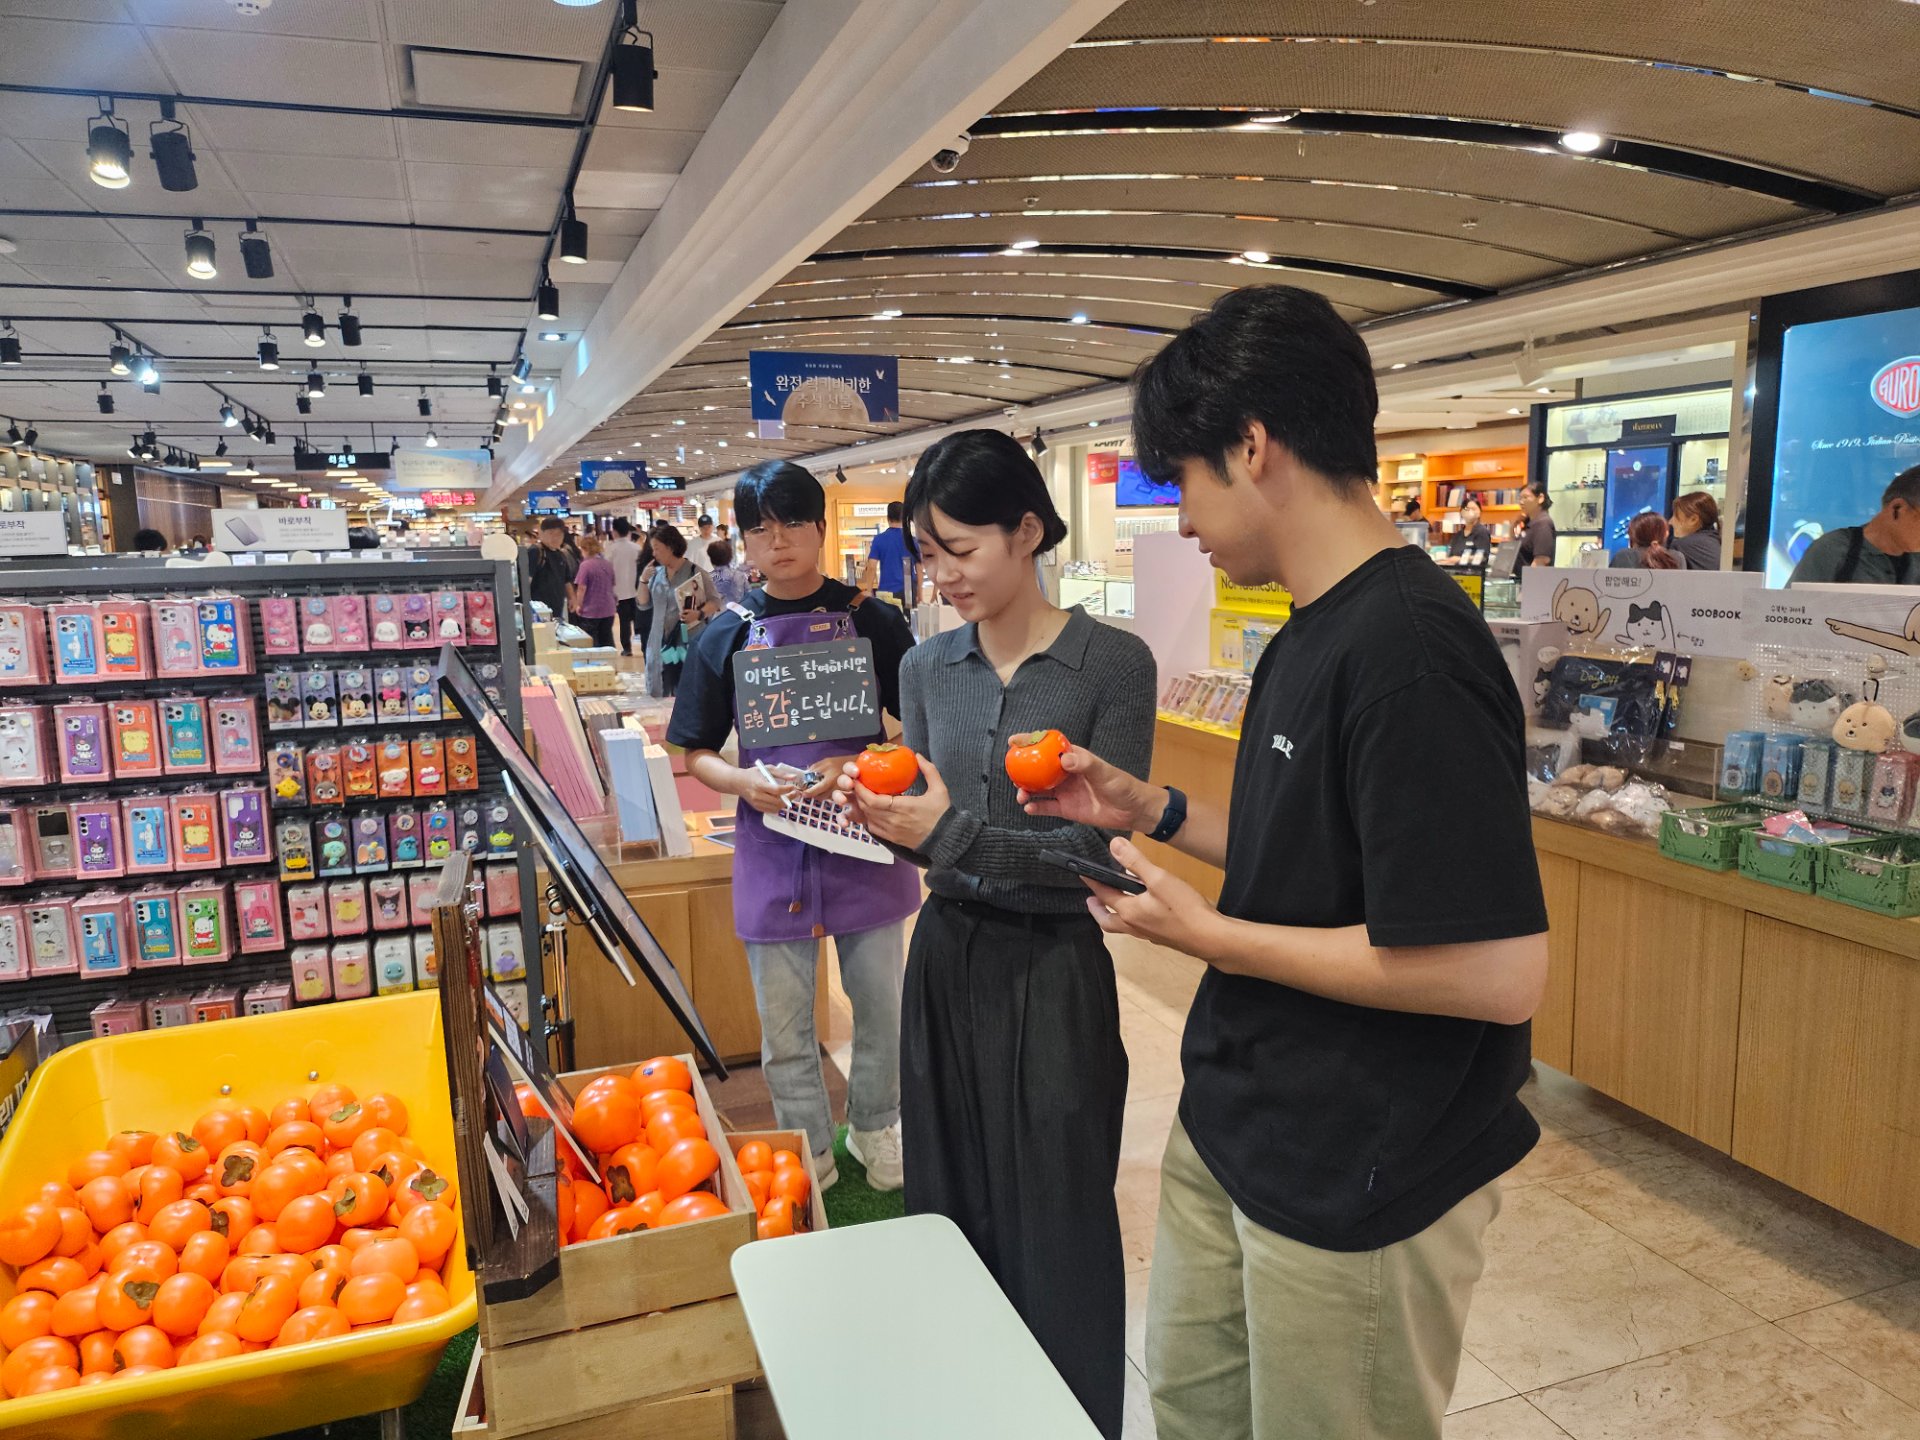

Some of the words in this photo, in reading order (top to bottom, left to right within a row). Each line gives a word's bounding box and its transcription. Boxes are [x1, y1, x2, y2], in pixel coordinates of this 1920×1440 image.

[775, 375, 802, 392] 완전
[1605, 576, 1642, 588] 팝업해요!
[1765, 614, 1813, 626] SOOBOOKZ
[800, 656, 867, 680] 참여하시면
